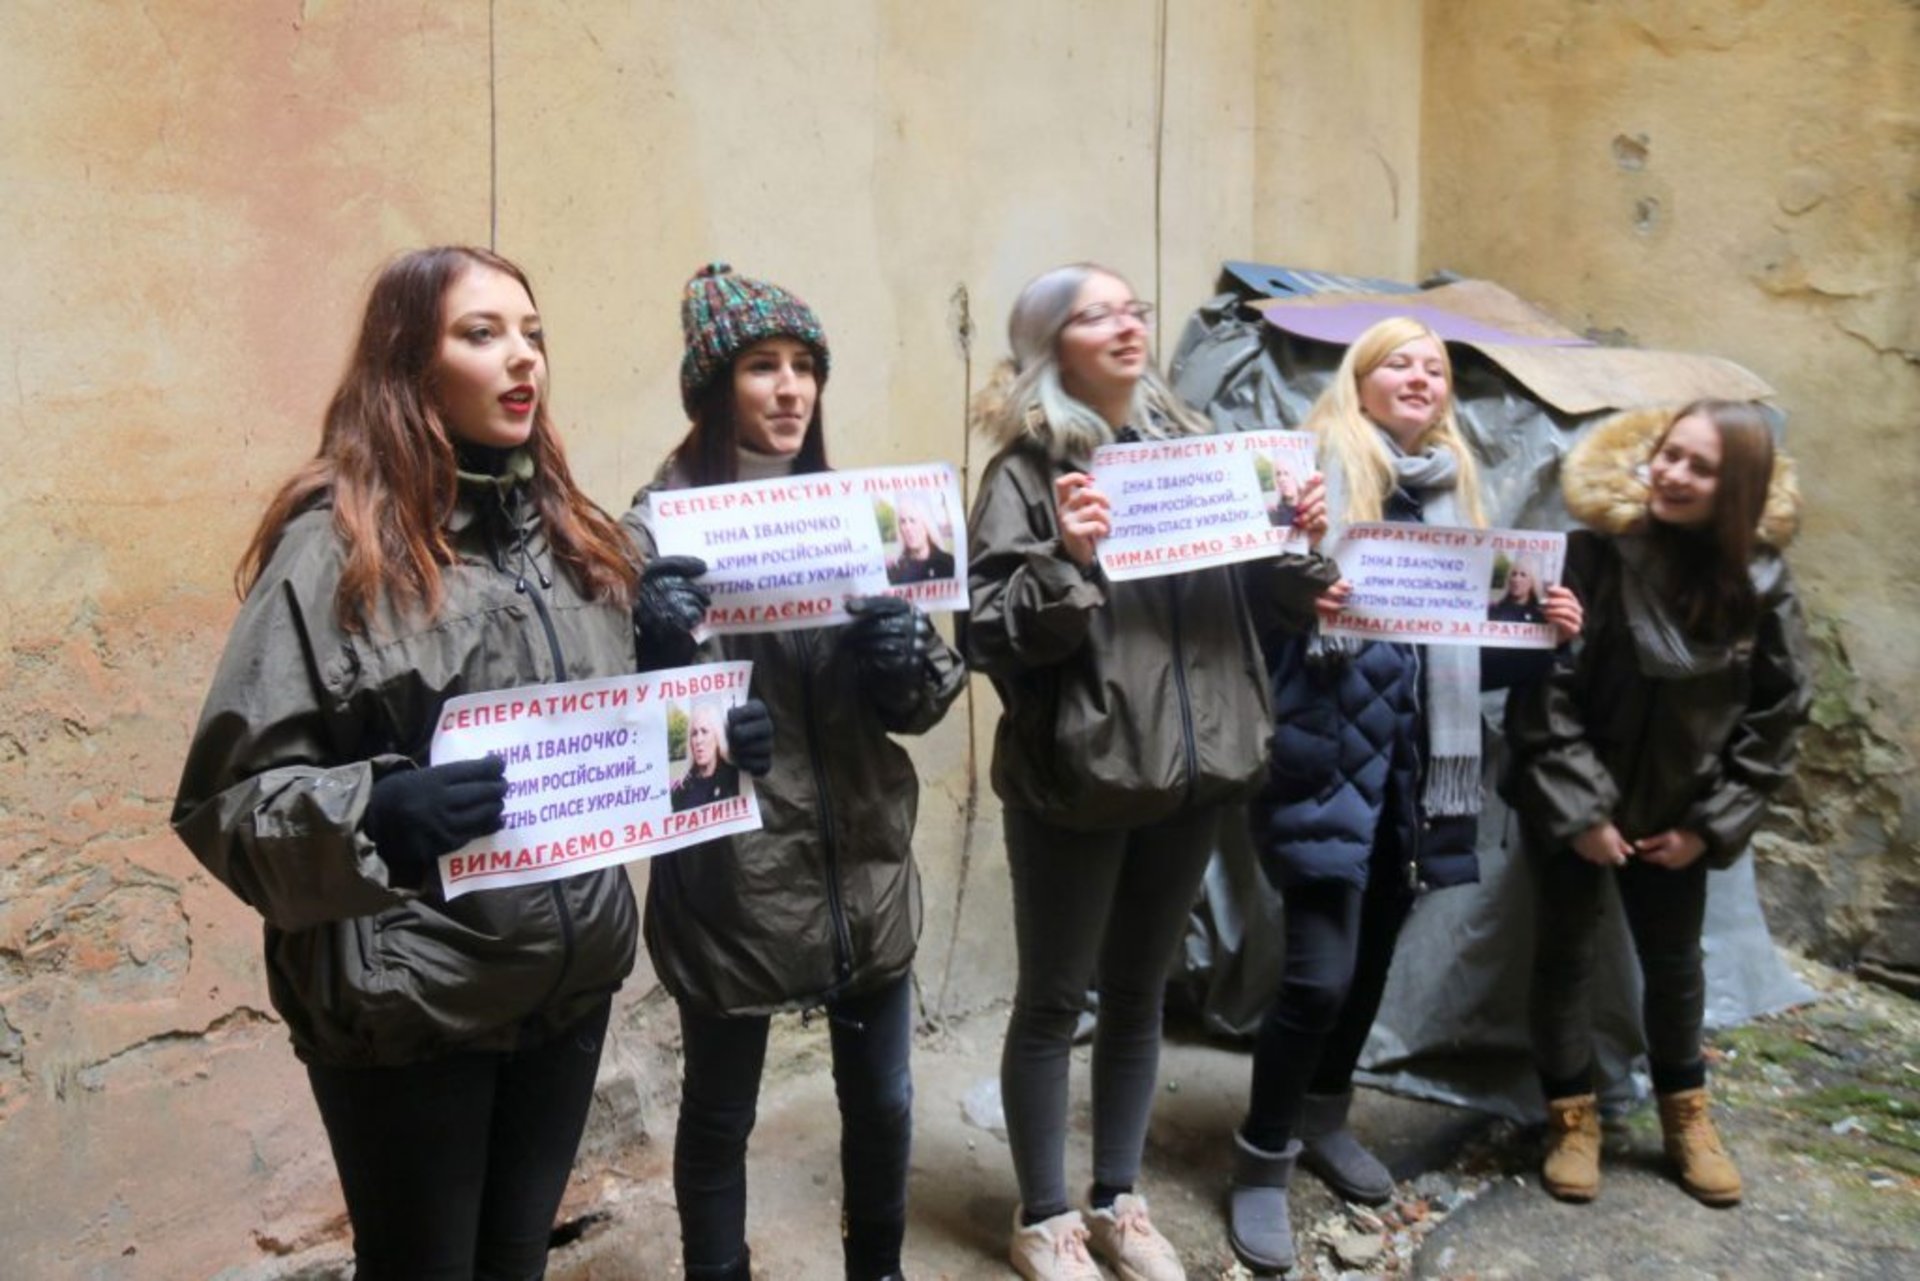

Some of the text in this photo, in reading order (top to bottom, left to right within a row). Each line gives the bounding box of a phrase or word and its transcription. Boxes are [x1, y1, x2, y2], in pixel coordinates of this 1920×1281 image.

[1224, 440, 1235, 452] У
[659, 486, 832, 517] СЕПЕРАТИСТИ
[841, 481, 852, 497] У
[704, 525, 750, 546] ІННА
[1231, 531, 1257, 549] ЗА
[1344, 526, 1467, 549] ЕПЕРАТИСТИ
[1474, 533, 1486, 546] У
[758, 569, 804, 590] СПАСЕ
[704, 597, 833, 625] МАГАЄМО
[1450, 621, 1471, 634] ЗА
[441, 671, 746, 732] СЕПЕРАТИСТИ У ЛЬВОВІ!
[540, 803, 584, 825] СПАСЕ
[450, 798, 750, 878] ВИМАГАЄМО ЗА ГРАТИ!!!
